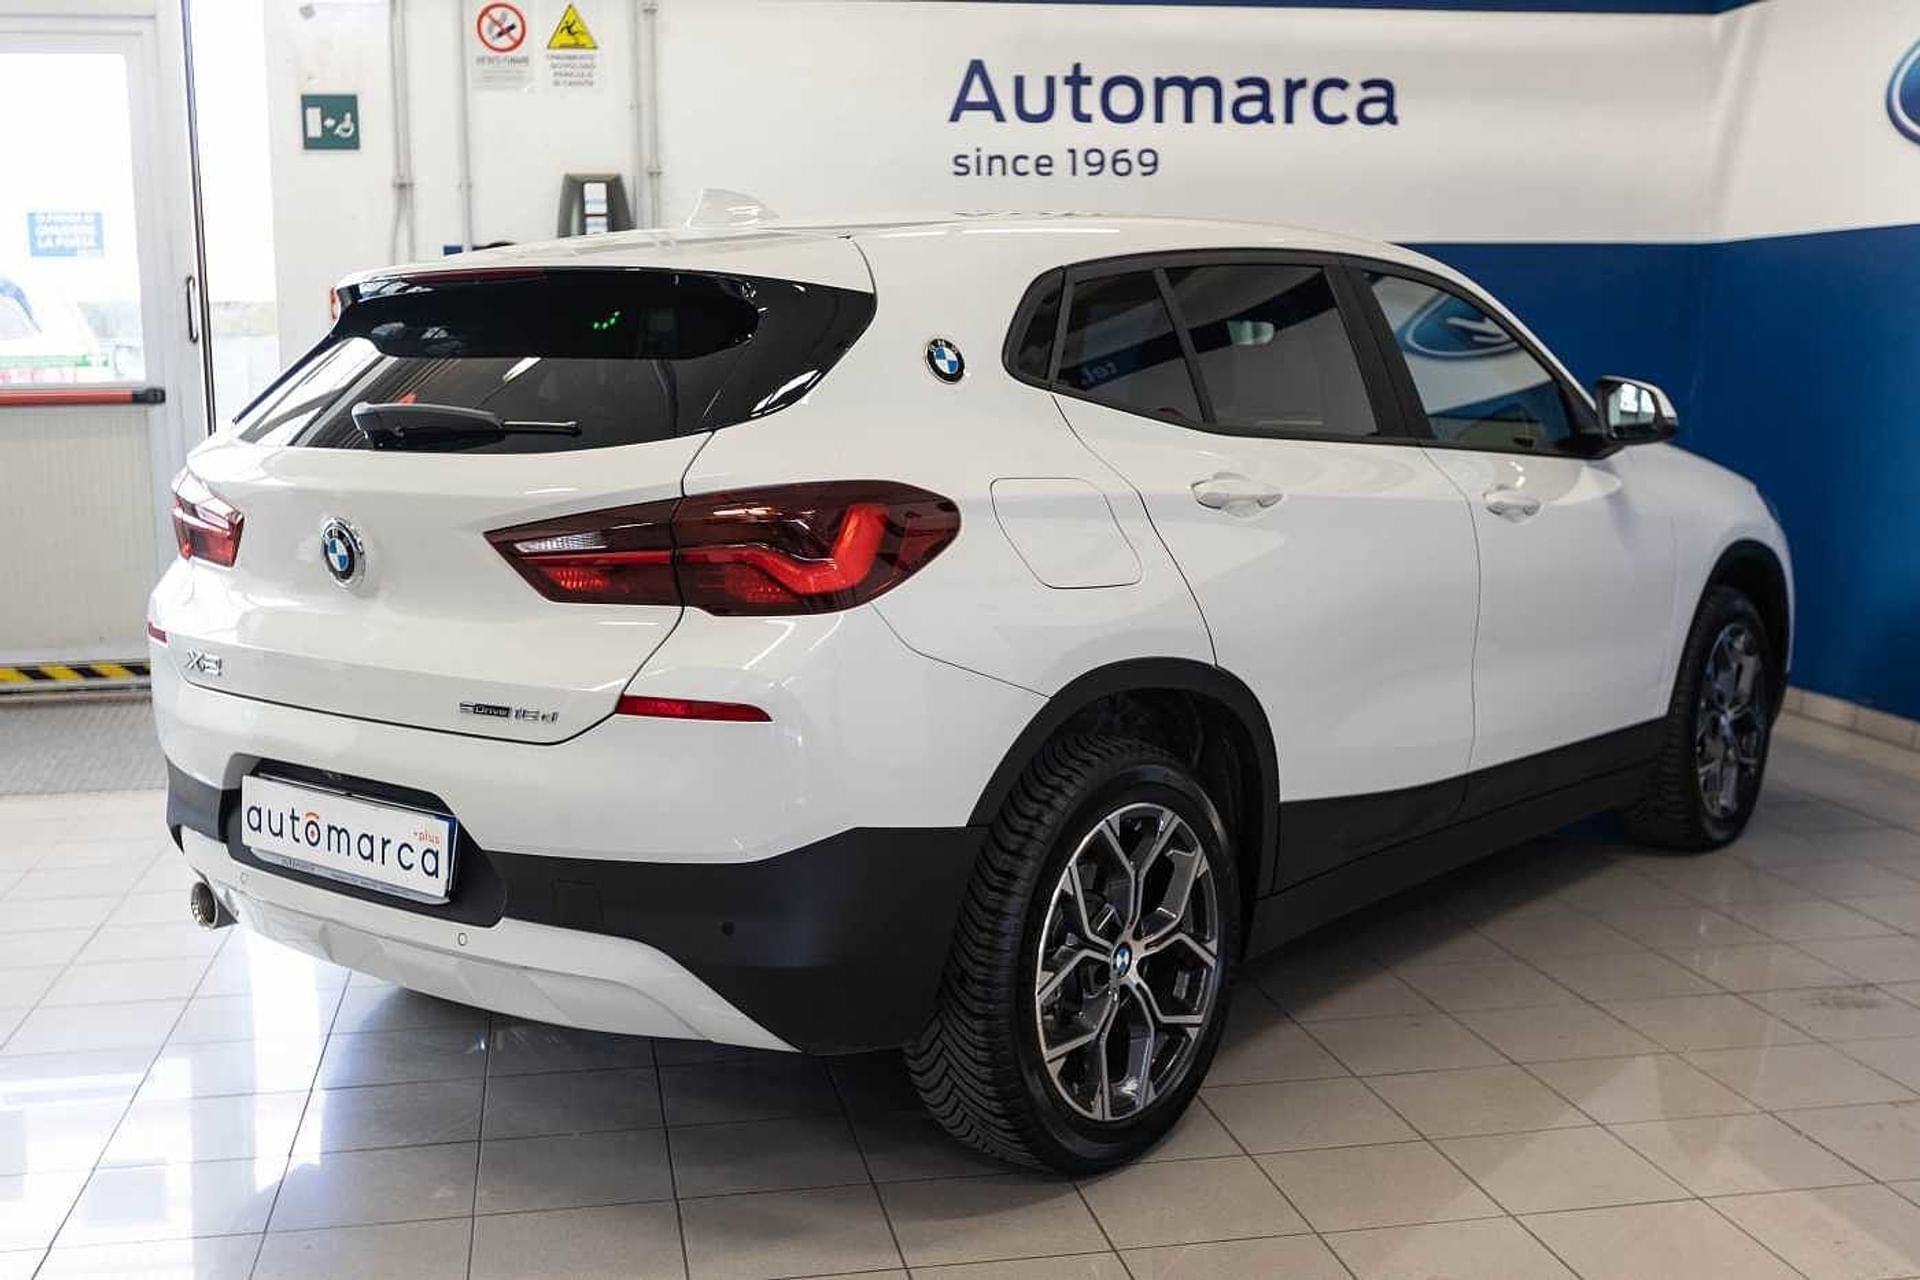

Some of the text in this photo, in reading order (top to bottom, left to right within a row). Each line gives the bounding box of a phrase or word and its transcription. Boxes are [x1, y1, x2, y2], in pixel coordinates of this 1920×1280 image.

[949, 58, 1398, 126] Automarca
[953, 147, 1159, 177] since 1969
[246, 804, 440, 879] automarca
